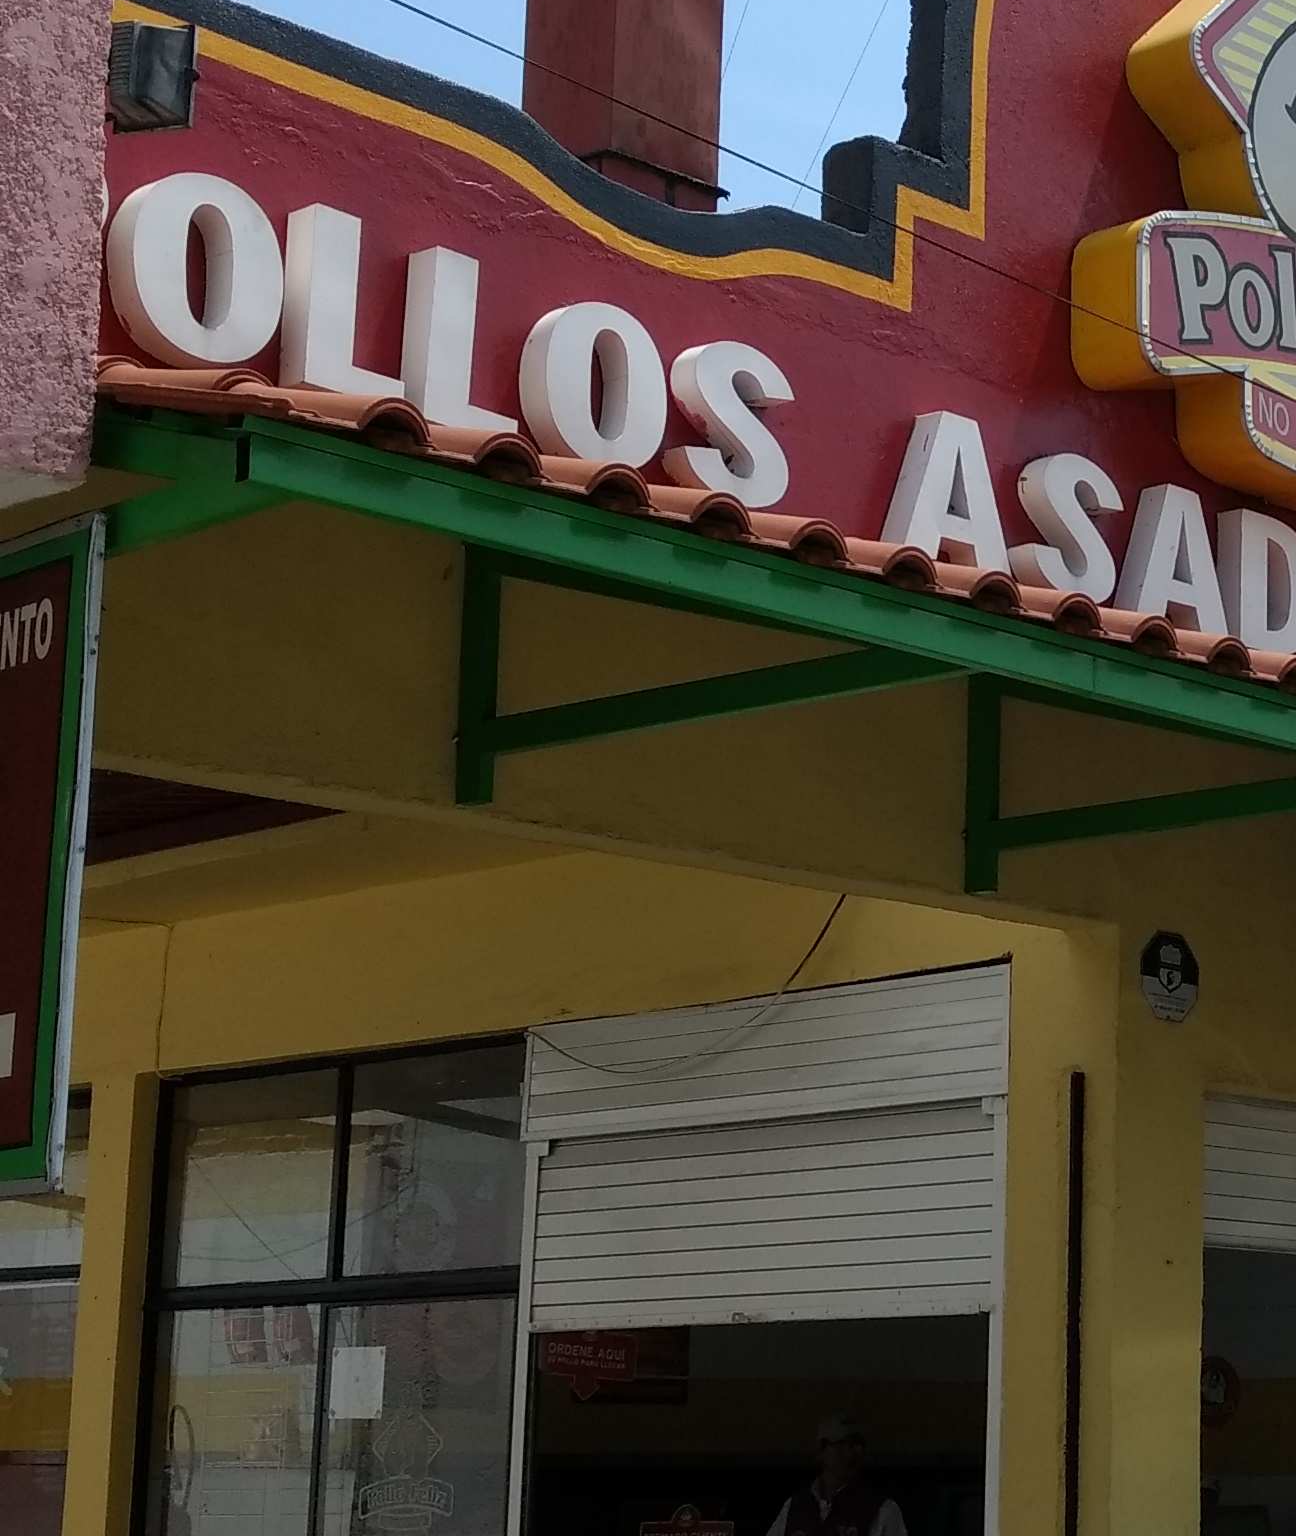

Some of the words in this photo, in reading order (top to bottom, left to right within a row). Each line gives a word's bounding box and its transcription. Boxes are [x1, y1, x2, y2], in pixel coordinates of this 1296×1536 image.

[100, 172, 796, 508] OLLOS
[1258, 391, 1290, 436] NO
[0, 597, 54, 671] NTO
[548, 1342, 594, 1358] ORDENE
